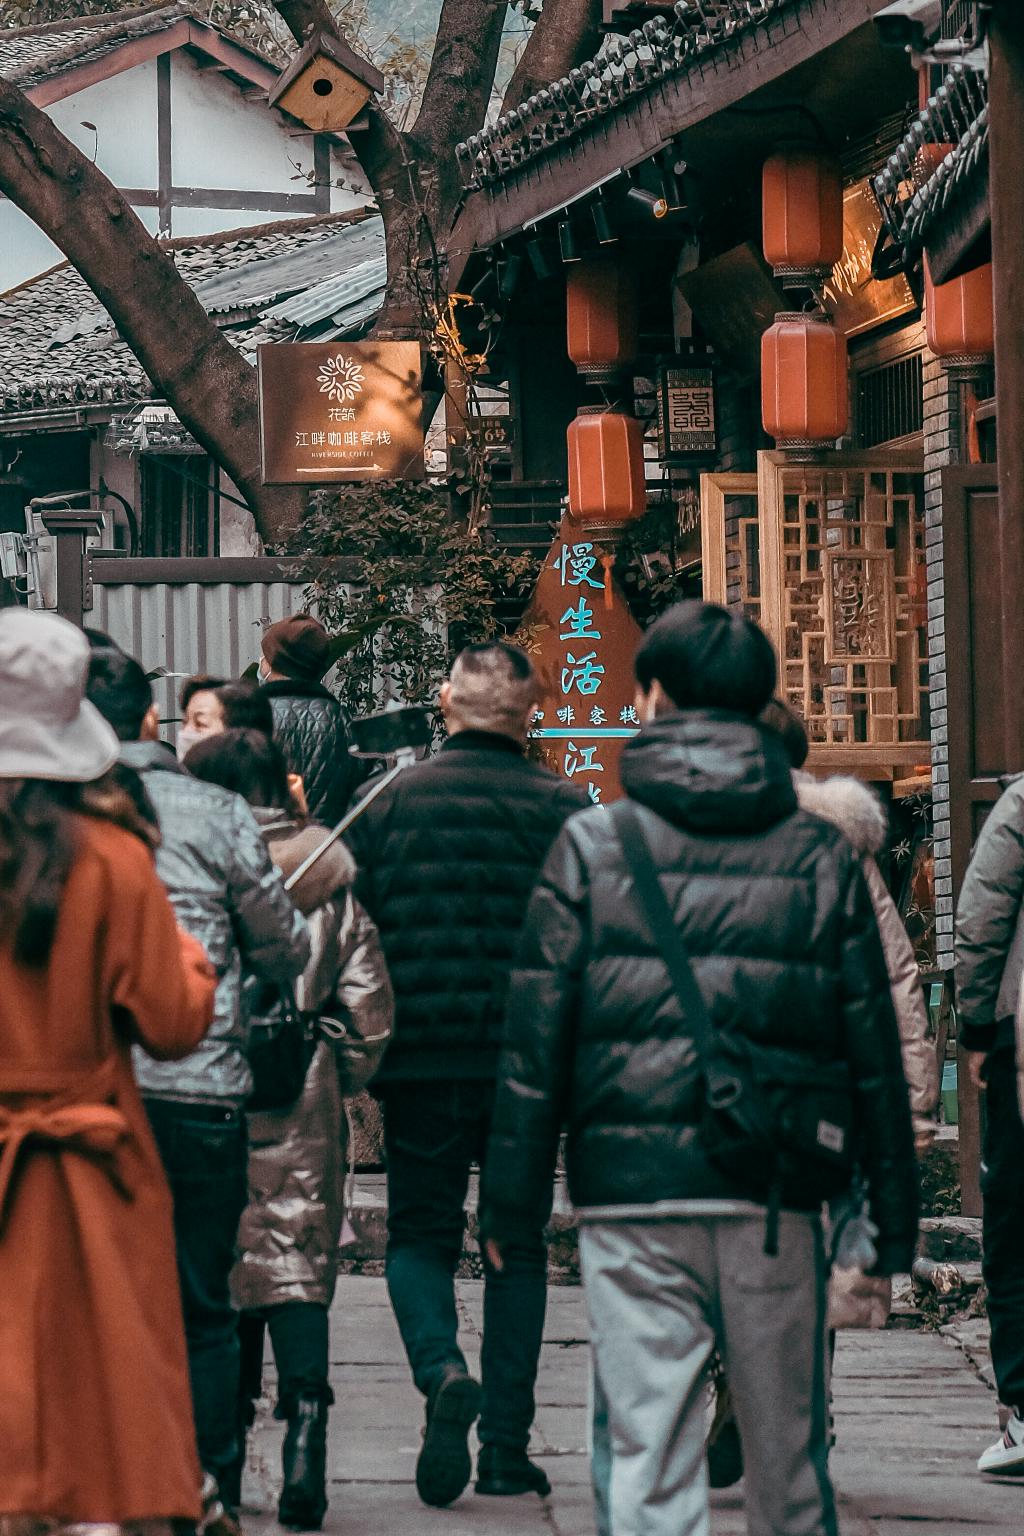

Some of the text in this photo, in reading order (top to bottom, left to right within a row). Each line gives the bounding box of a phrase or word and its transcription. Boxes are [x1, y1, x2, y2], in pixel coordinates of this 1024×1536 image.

[295, 430, 392, 447] 江畔咖啡客栈
[553, 542, 606, 696] 慢生活
